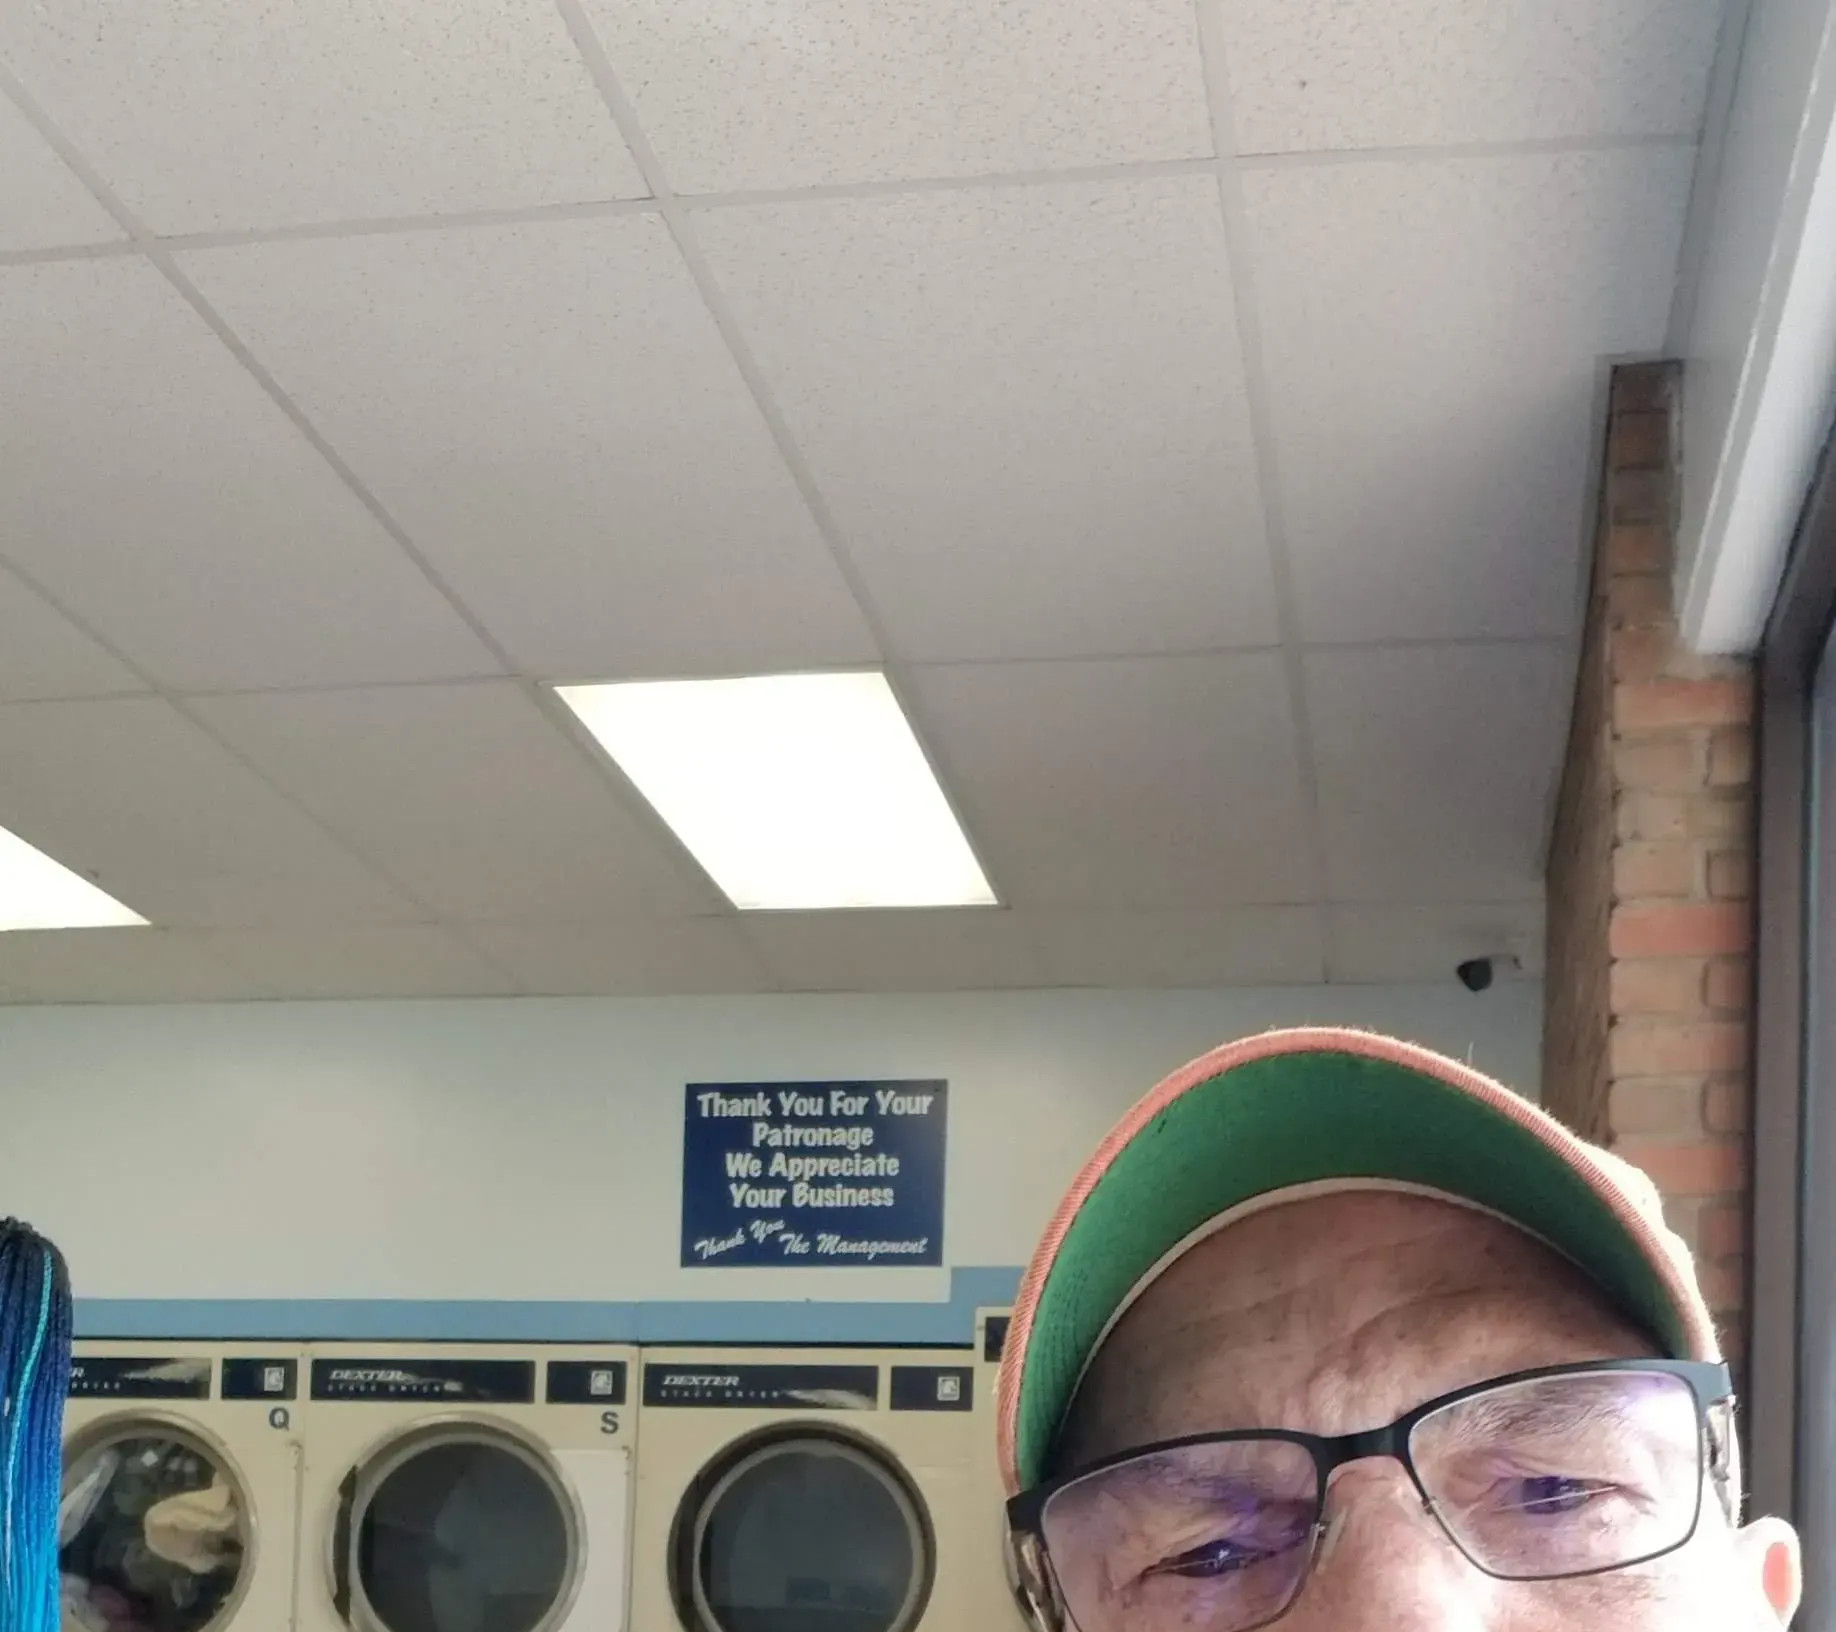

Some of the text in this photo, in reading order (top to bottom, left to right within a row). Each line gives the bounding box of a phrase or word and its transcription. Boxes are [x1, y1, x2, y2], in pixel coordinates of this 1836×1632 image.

[697, 1090, 934, 1117] Thank You For Your
[752, 1122, 874, 1150] Patronage
[725, 1152, 900, 1181] We Appreciate
[729, 1182, 894, 1208] Your Business
[694, 1219, 785, 1259] Thank You
[779, 1233, 928, 1260] The Management
[329, 1369, 403, 1381] DEXTER
[662, 1375, 740, 1386] DEXTER
[269, 1407, 290, 1431] Q
[600, 1411, 619, 1434] S
